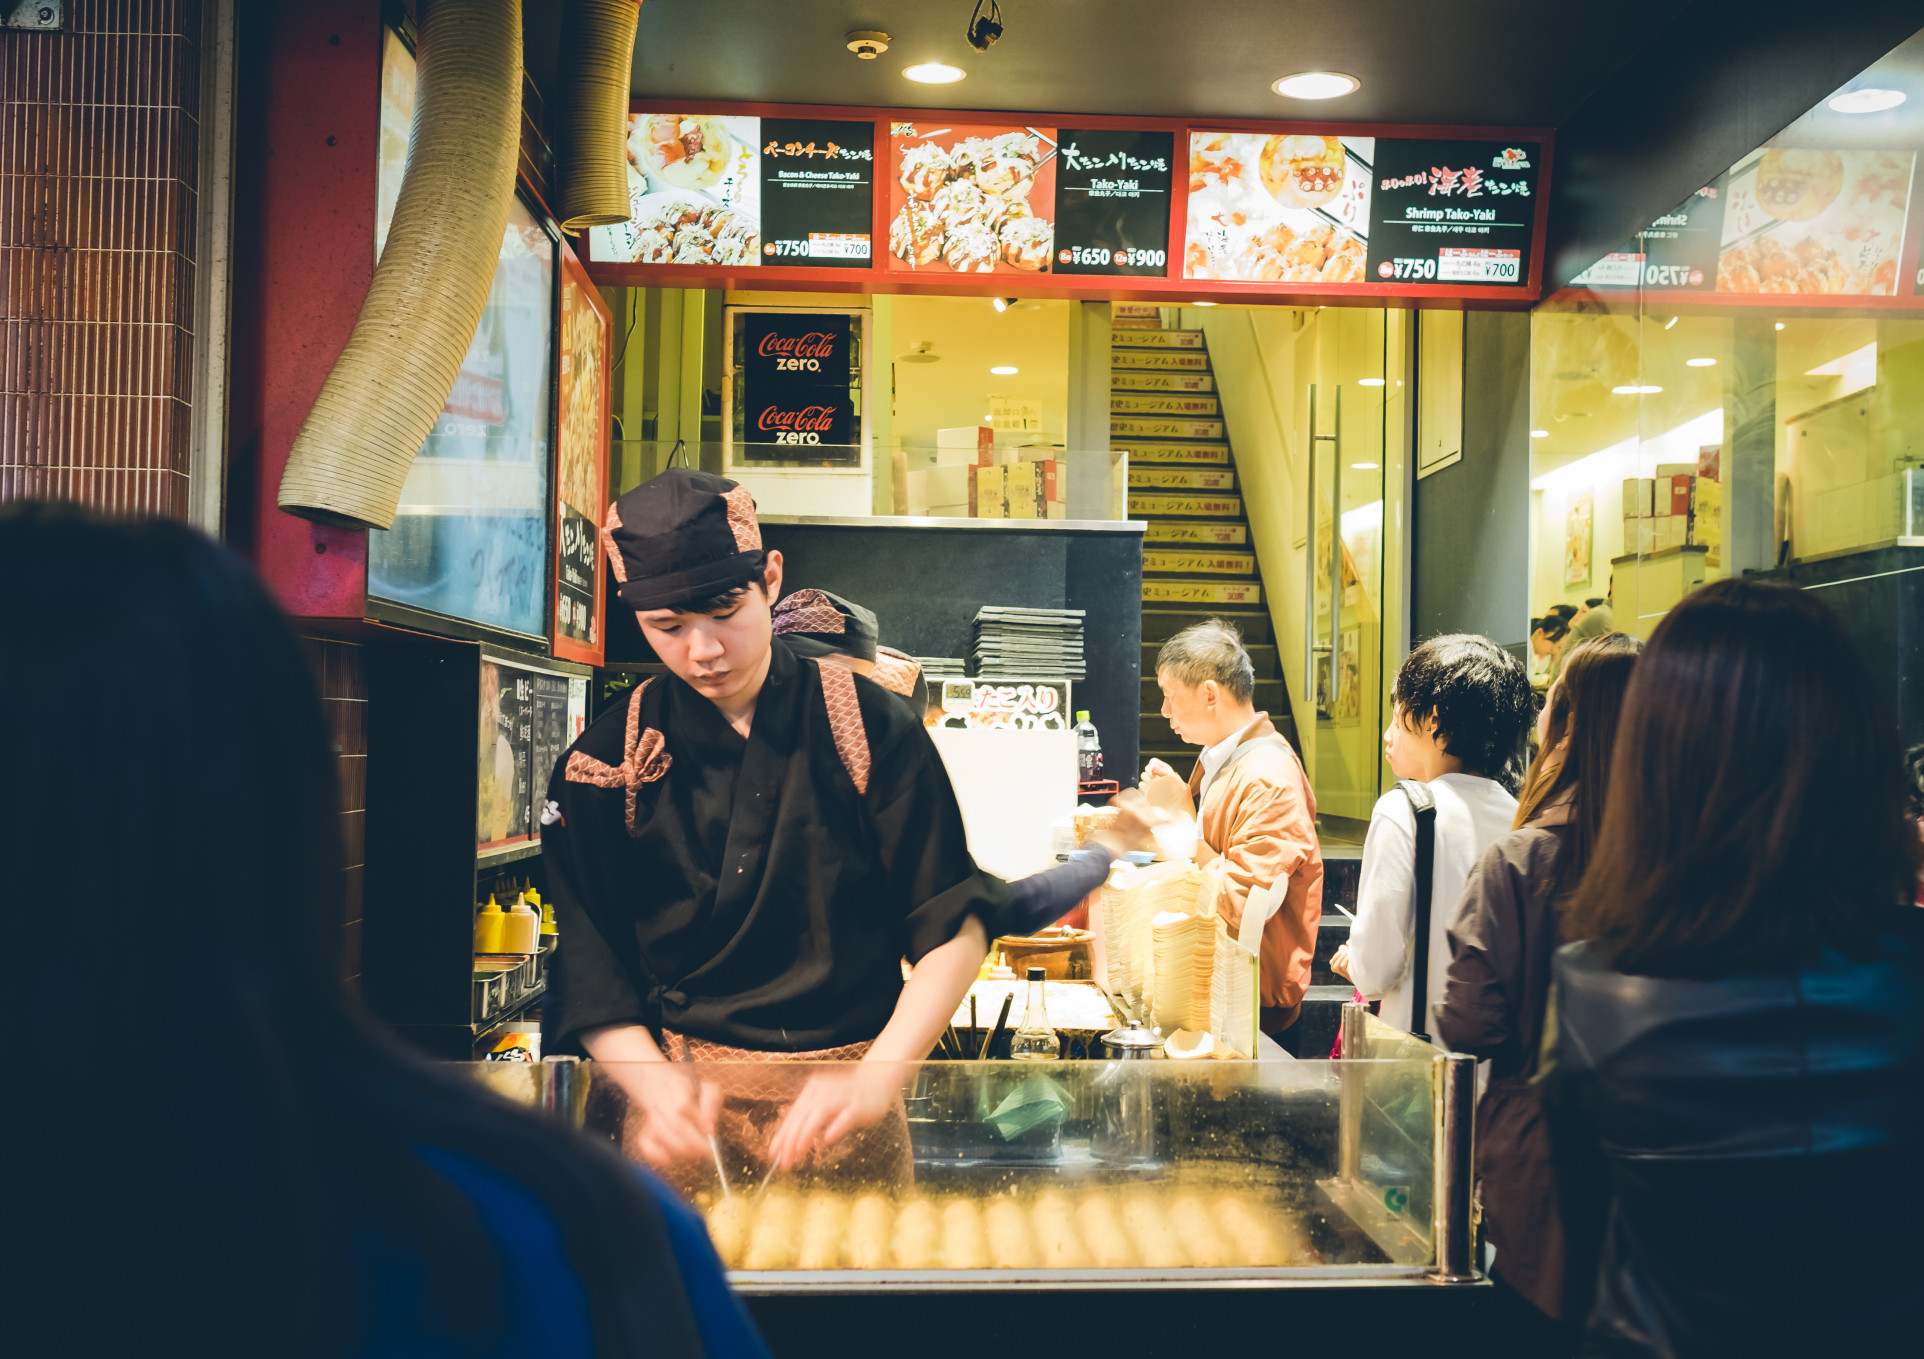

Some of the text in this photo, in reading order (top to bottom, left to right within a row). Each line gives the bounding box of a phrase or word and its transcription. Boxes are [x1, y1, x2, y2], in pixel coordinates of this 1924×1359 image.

[1090, 178, 1139, 190] Tako-Yaki
[1406, 207, 1496, 221] Shrimp Tako-Yaki
[775, 240, 809, 256] ¥750
[844, 244, 867, 255] ¥700
[1072, 248, 1111, 265] ¥650
[1127, 249, 1166, 267] ¥900
[1393, 258, 1436, 279] ¥750
[1485, 263, 1515, 277] ¥700
[758, 331, 838, 358] Coca-Cola
[758, 405, 838, 431] Coca-Cola
